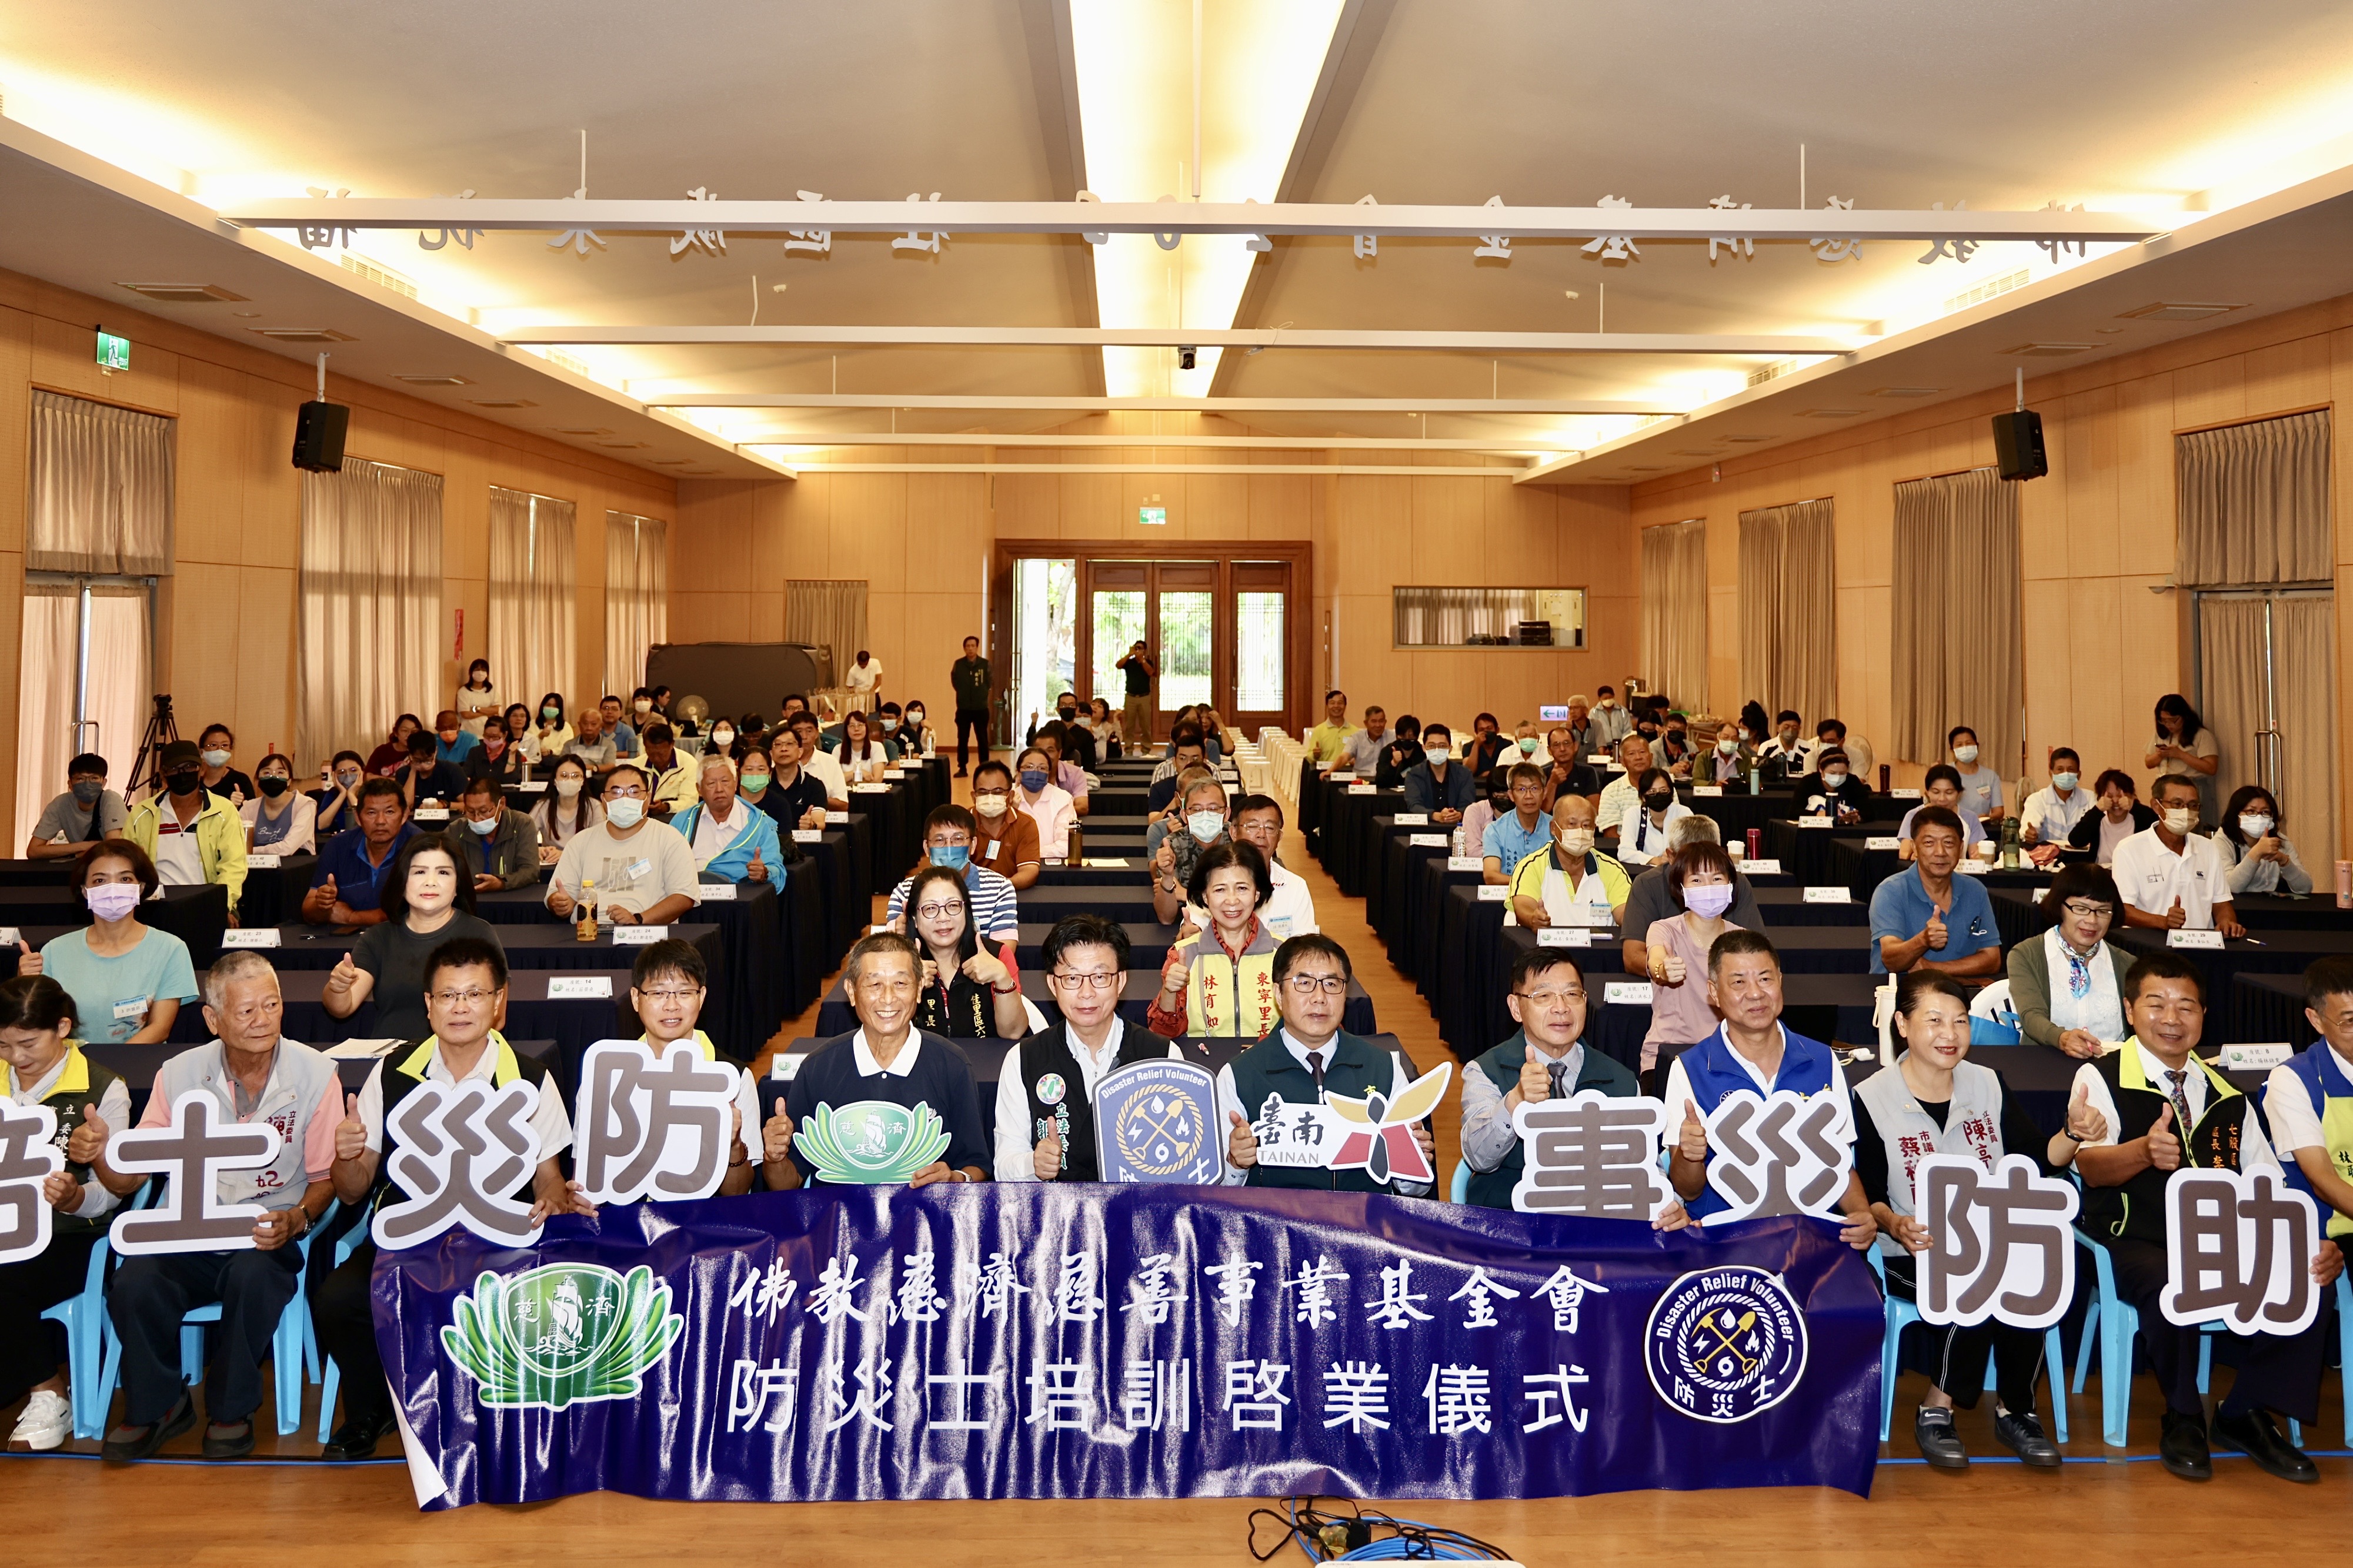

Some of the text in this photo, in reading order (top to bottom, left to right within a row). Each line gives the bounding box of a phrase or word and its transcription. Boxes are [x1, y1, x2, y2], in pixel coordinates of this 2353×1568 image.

[925, 999, 936, 1027] 里長
[970, 993, 986, 1038] 佳里區六
[1203, 974, 1219, 1028] 林育如
[1256, 971, 1272, 1035] 東寧里長
[1101, 1068, 1207, 1099] Disaster Relief Volunteer
[285, 1111, 296, 1144] 立法委員
[586, 1050, 729, 1195] 防
[1254, 1096, 1324, 1146] 臺南
[1918, 1131, 1935, 1155] 市議
[1982, 1110, 1998, 1143] 立法委員
[118, 1101, 269, 1243] 士
[383, 1091, 533, 1238] 災
[1258, 1151, 1319, 1164] TAINAN
[1524, 1101, 1663, 1221] 事
[1714, 1100, 1841, 1217] 災
[1928, 1165, 2068, 1316] 防
[2172, 1175, 2309, 1323] 助
[730, 1252, 1610, 1335] 佛教慈濟慈善事業基金會
[1656, 1273, 1794, 1342] Disaster Relief Volunteer
[1674, 1375, 1775, 1417] 防災士
